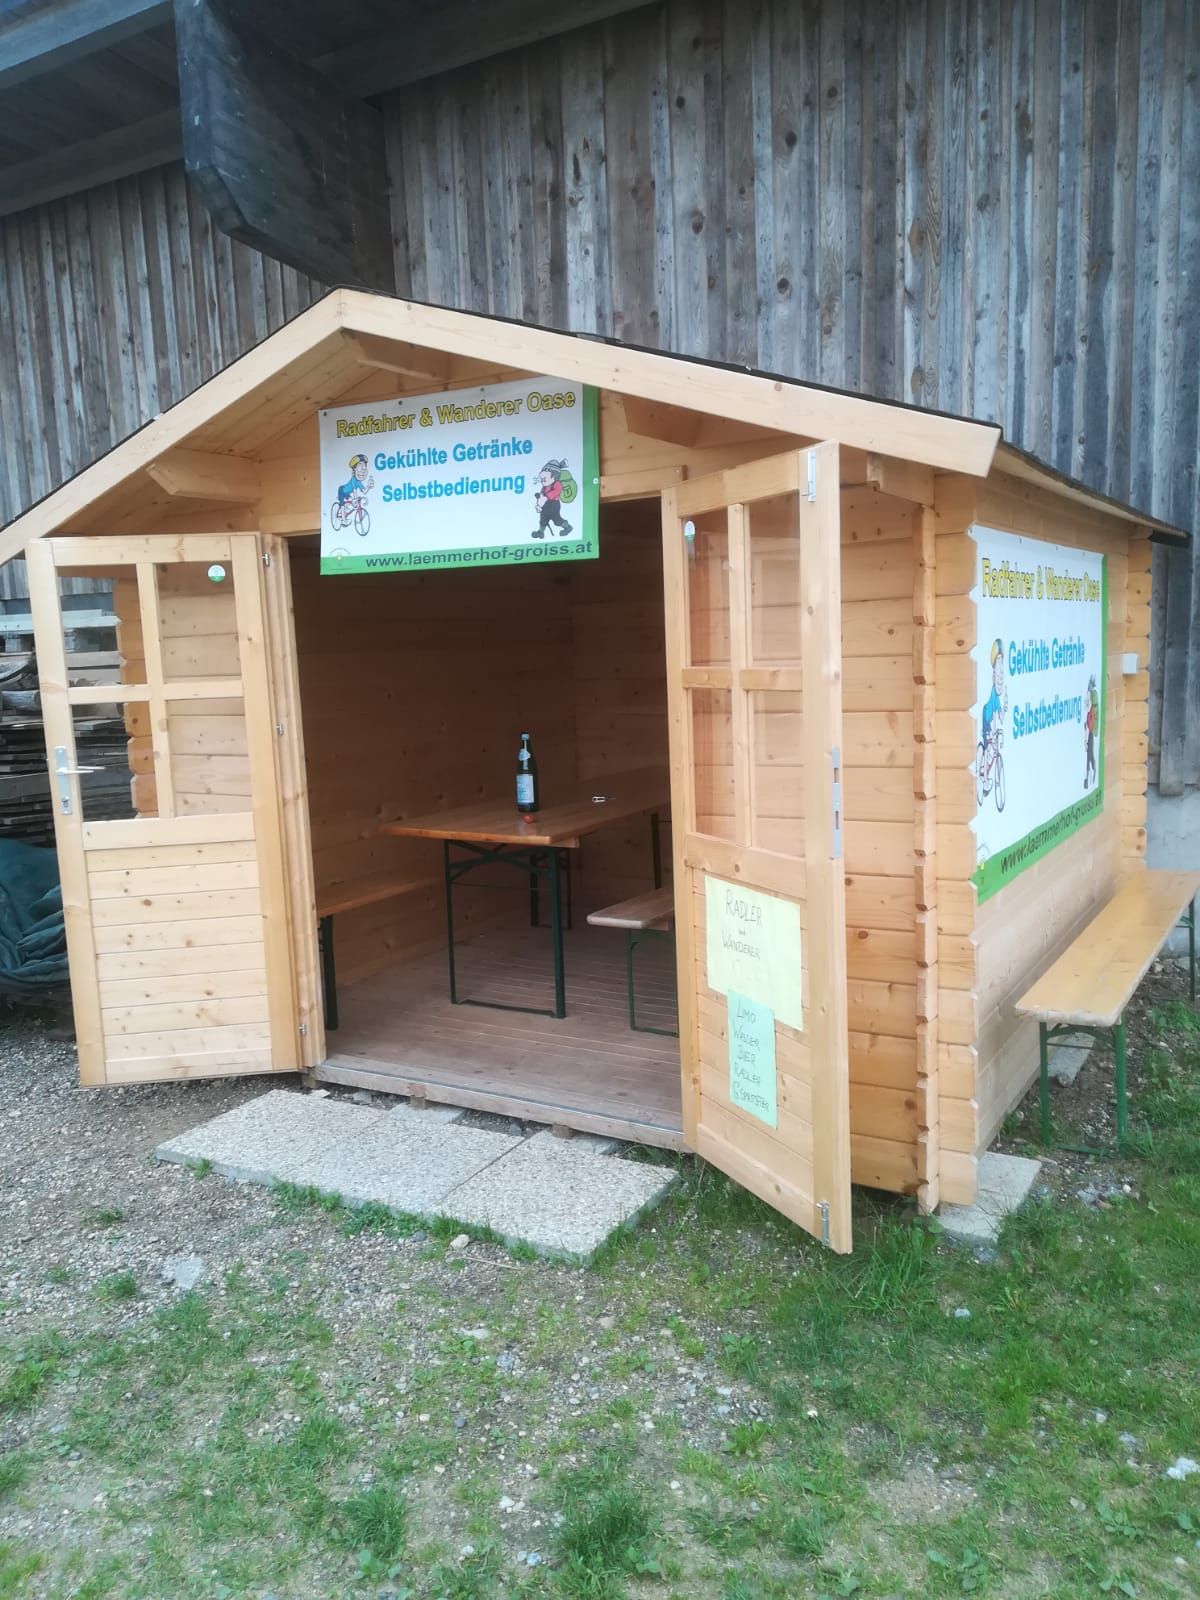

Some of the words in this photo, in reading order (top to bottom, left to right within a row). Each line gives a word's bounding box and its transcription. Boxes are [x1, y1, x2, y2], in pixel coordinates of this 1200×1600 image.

[336, 411, 416, 438] Radfahrer
[419, 408, 433, 427] &
[436, 395, 523, 425] Wanderer
[526, 391, 576, 412] Oase
[374, 447, 448, 472] Gekühlte
[452, 436, 533, 462] Getränke
[382, 473, 525, 503] Selbstbedienung
[365, 540, 593, 568] www.laemmerhof-groiss.at
[982, 557, 1034, 599] Radfahrer
[1008, 639, 1050, 677] Gekühlte
[1052, 635, 1085, 669] Getränke
[1012, 694, 1083, 740] Selbstbedienung
[725, 888, 762, 927] RADLER
